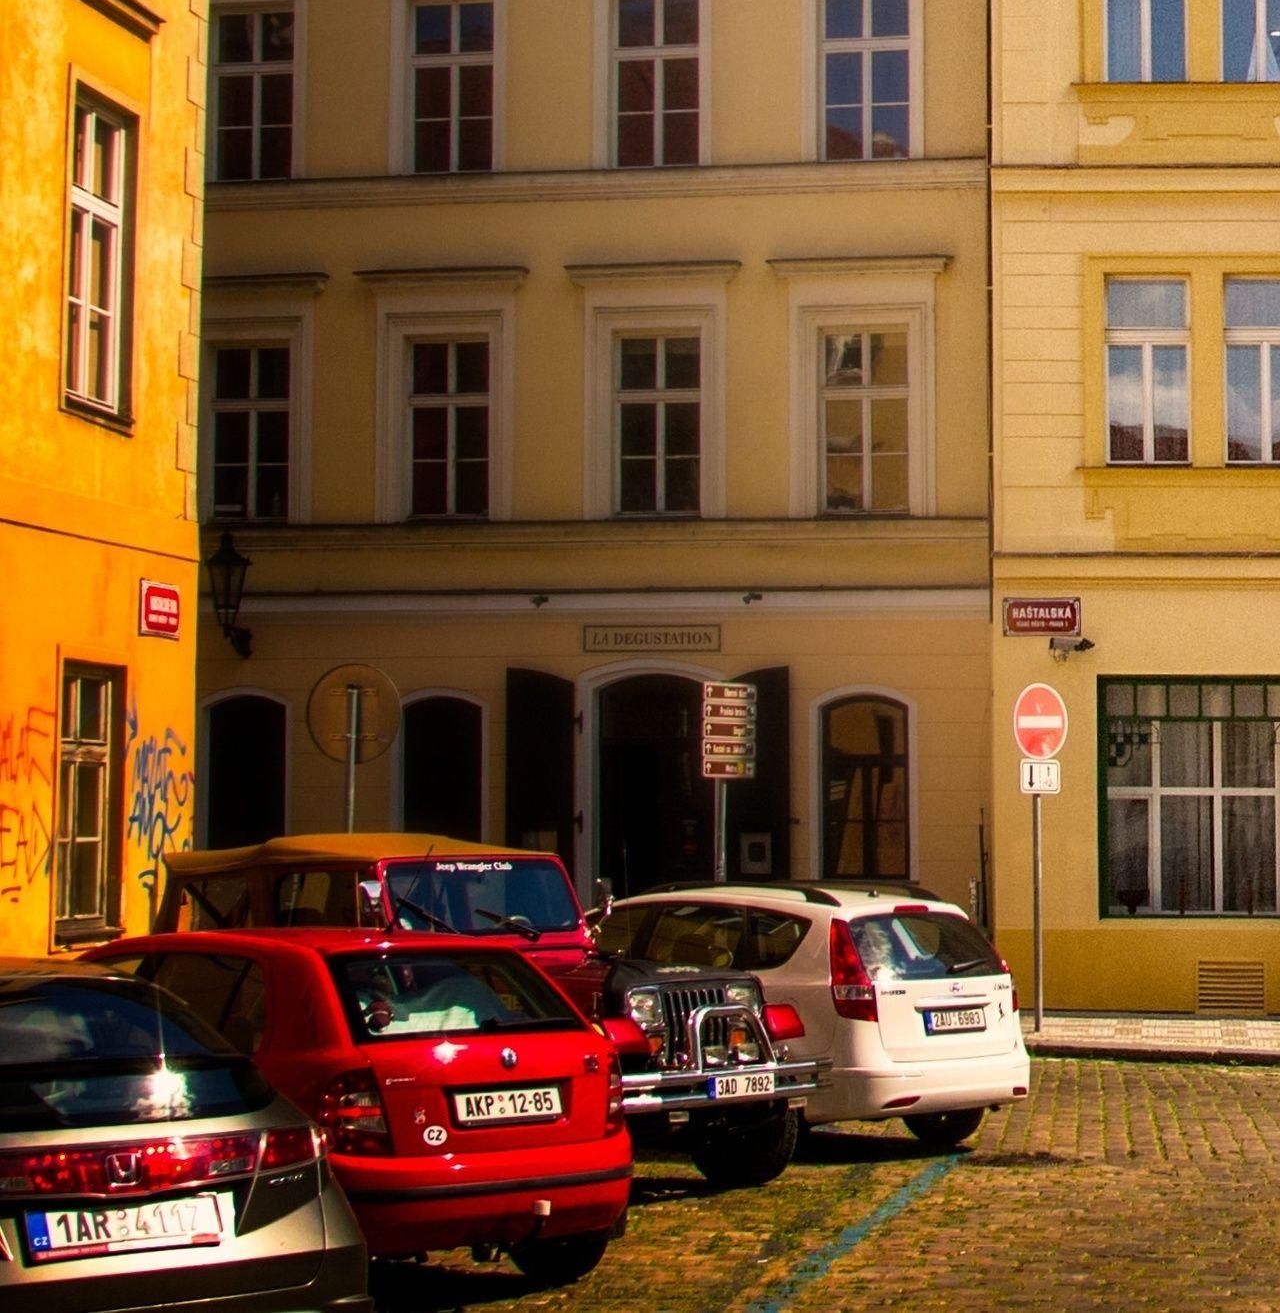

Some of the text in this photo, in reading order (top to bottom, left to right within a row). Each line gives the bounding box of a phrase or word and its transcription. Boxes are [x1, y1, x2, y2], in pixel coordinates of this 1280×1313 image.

[1012, 605, 1072, 618] HAŠTALSKÁ
[592, 631, 712, 645] LA DEGUSTATION
[436, 861, 513, 872] Jeep Wrangler Club
[933, 1011, 981, 1028] 2AU 6983
[718, 1076, 770, 1096] 3AD 7892
[465, 1091, 554, 1118] AKP 12-85
[427, 1128, 443, 1142] CZ
[56, 1211, 112, 1243] 1AR
[34, 1236, 48, 1247] CZ
